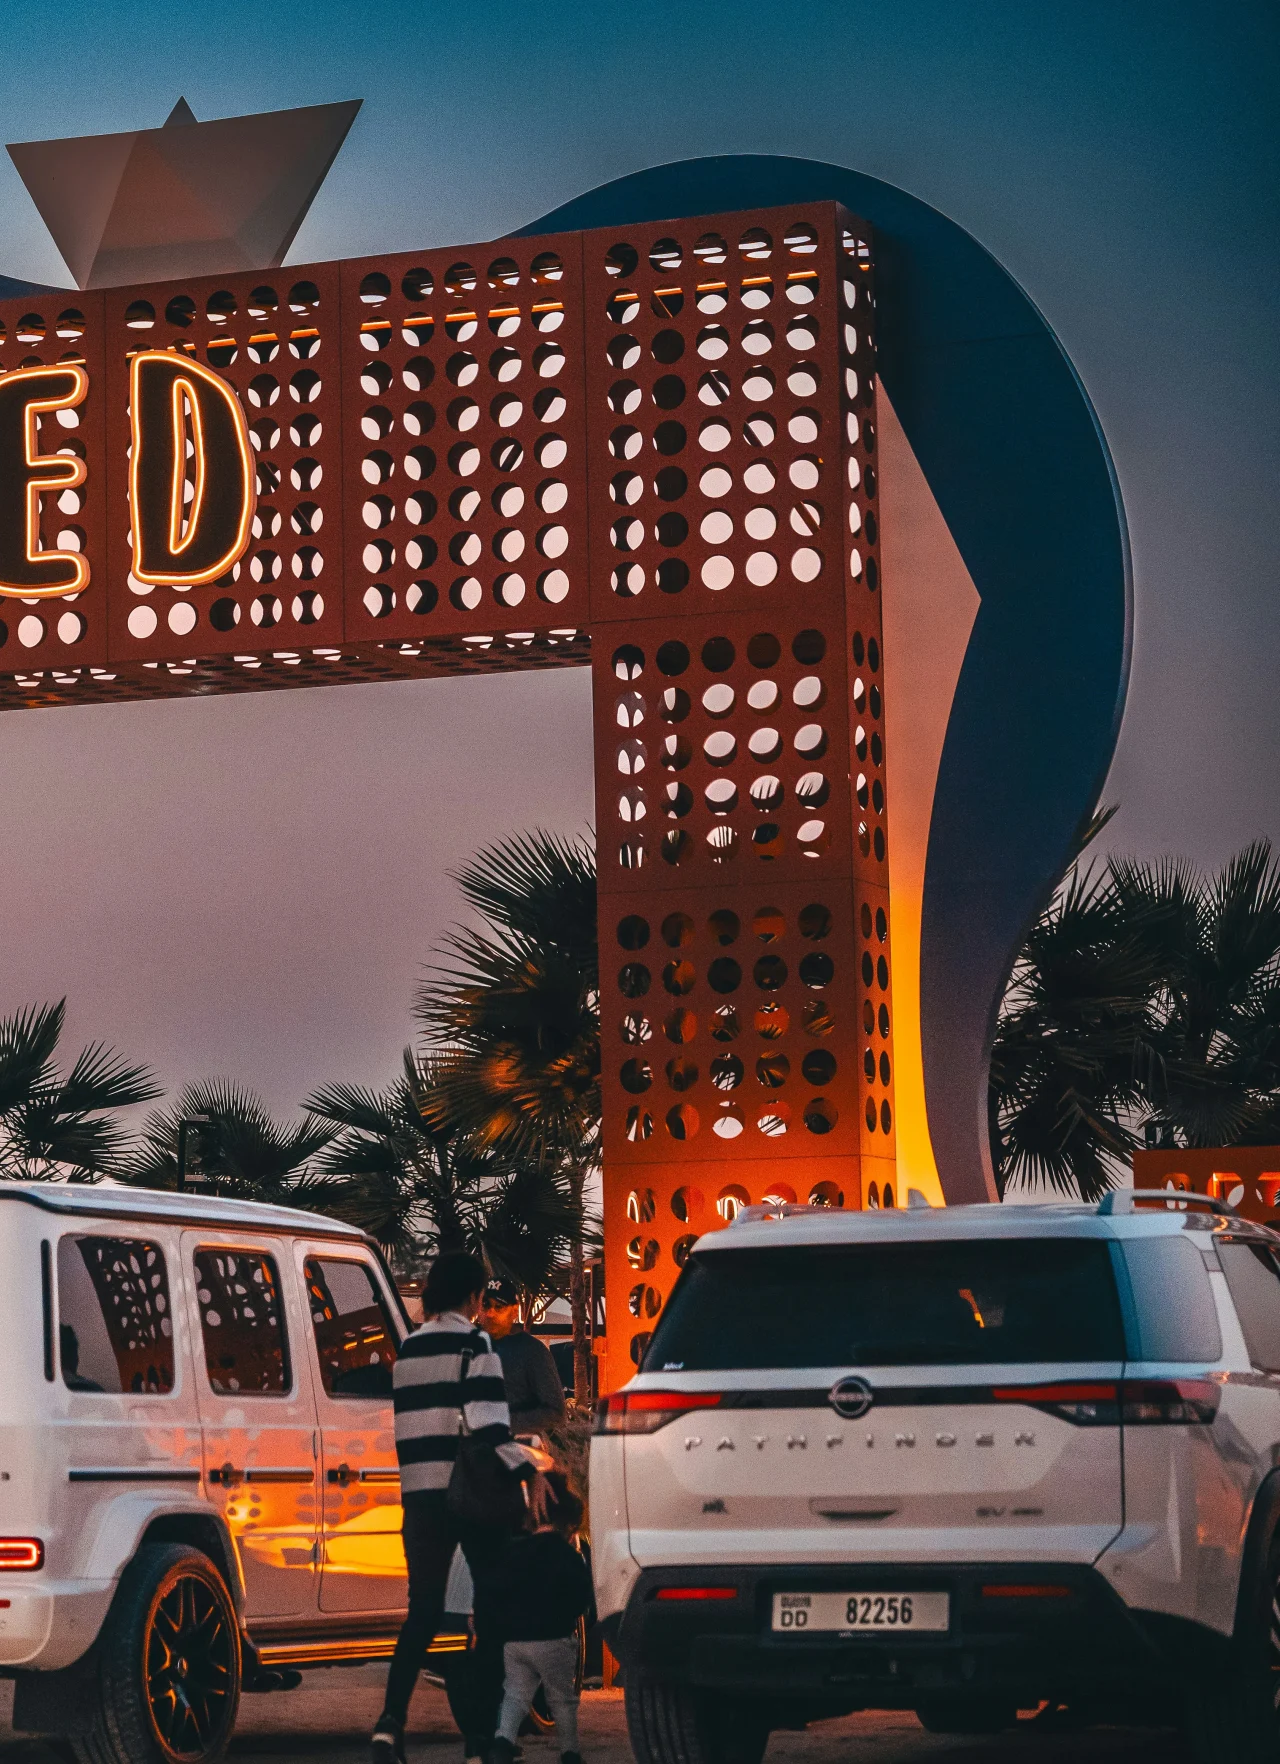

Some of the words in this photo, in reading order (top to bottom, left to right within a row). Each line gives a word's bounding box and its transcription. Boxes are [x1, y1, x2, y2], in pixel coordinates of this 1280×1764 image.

[684, 1433, 1036, 1451] PATHFINDER
[781, 1610, 808, 1627] DD
[846, 1597, 913, 1624] 82256
